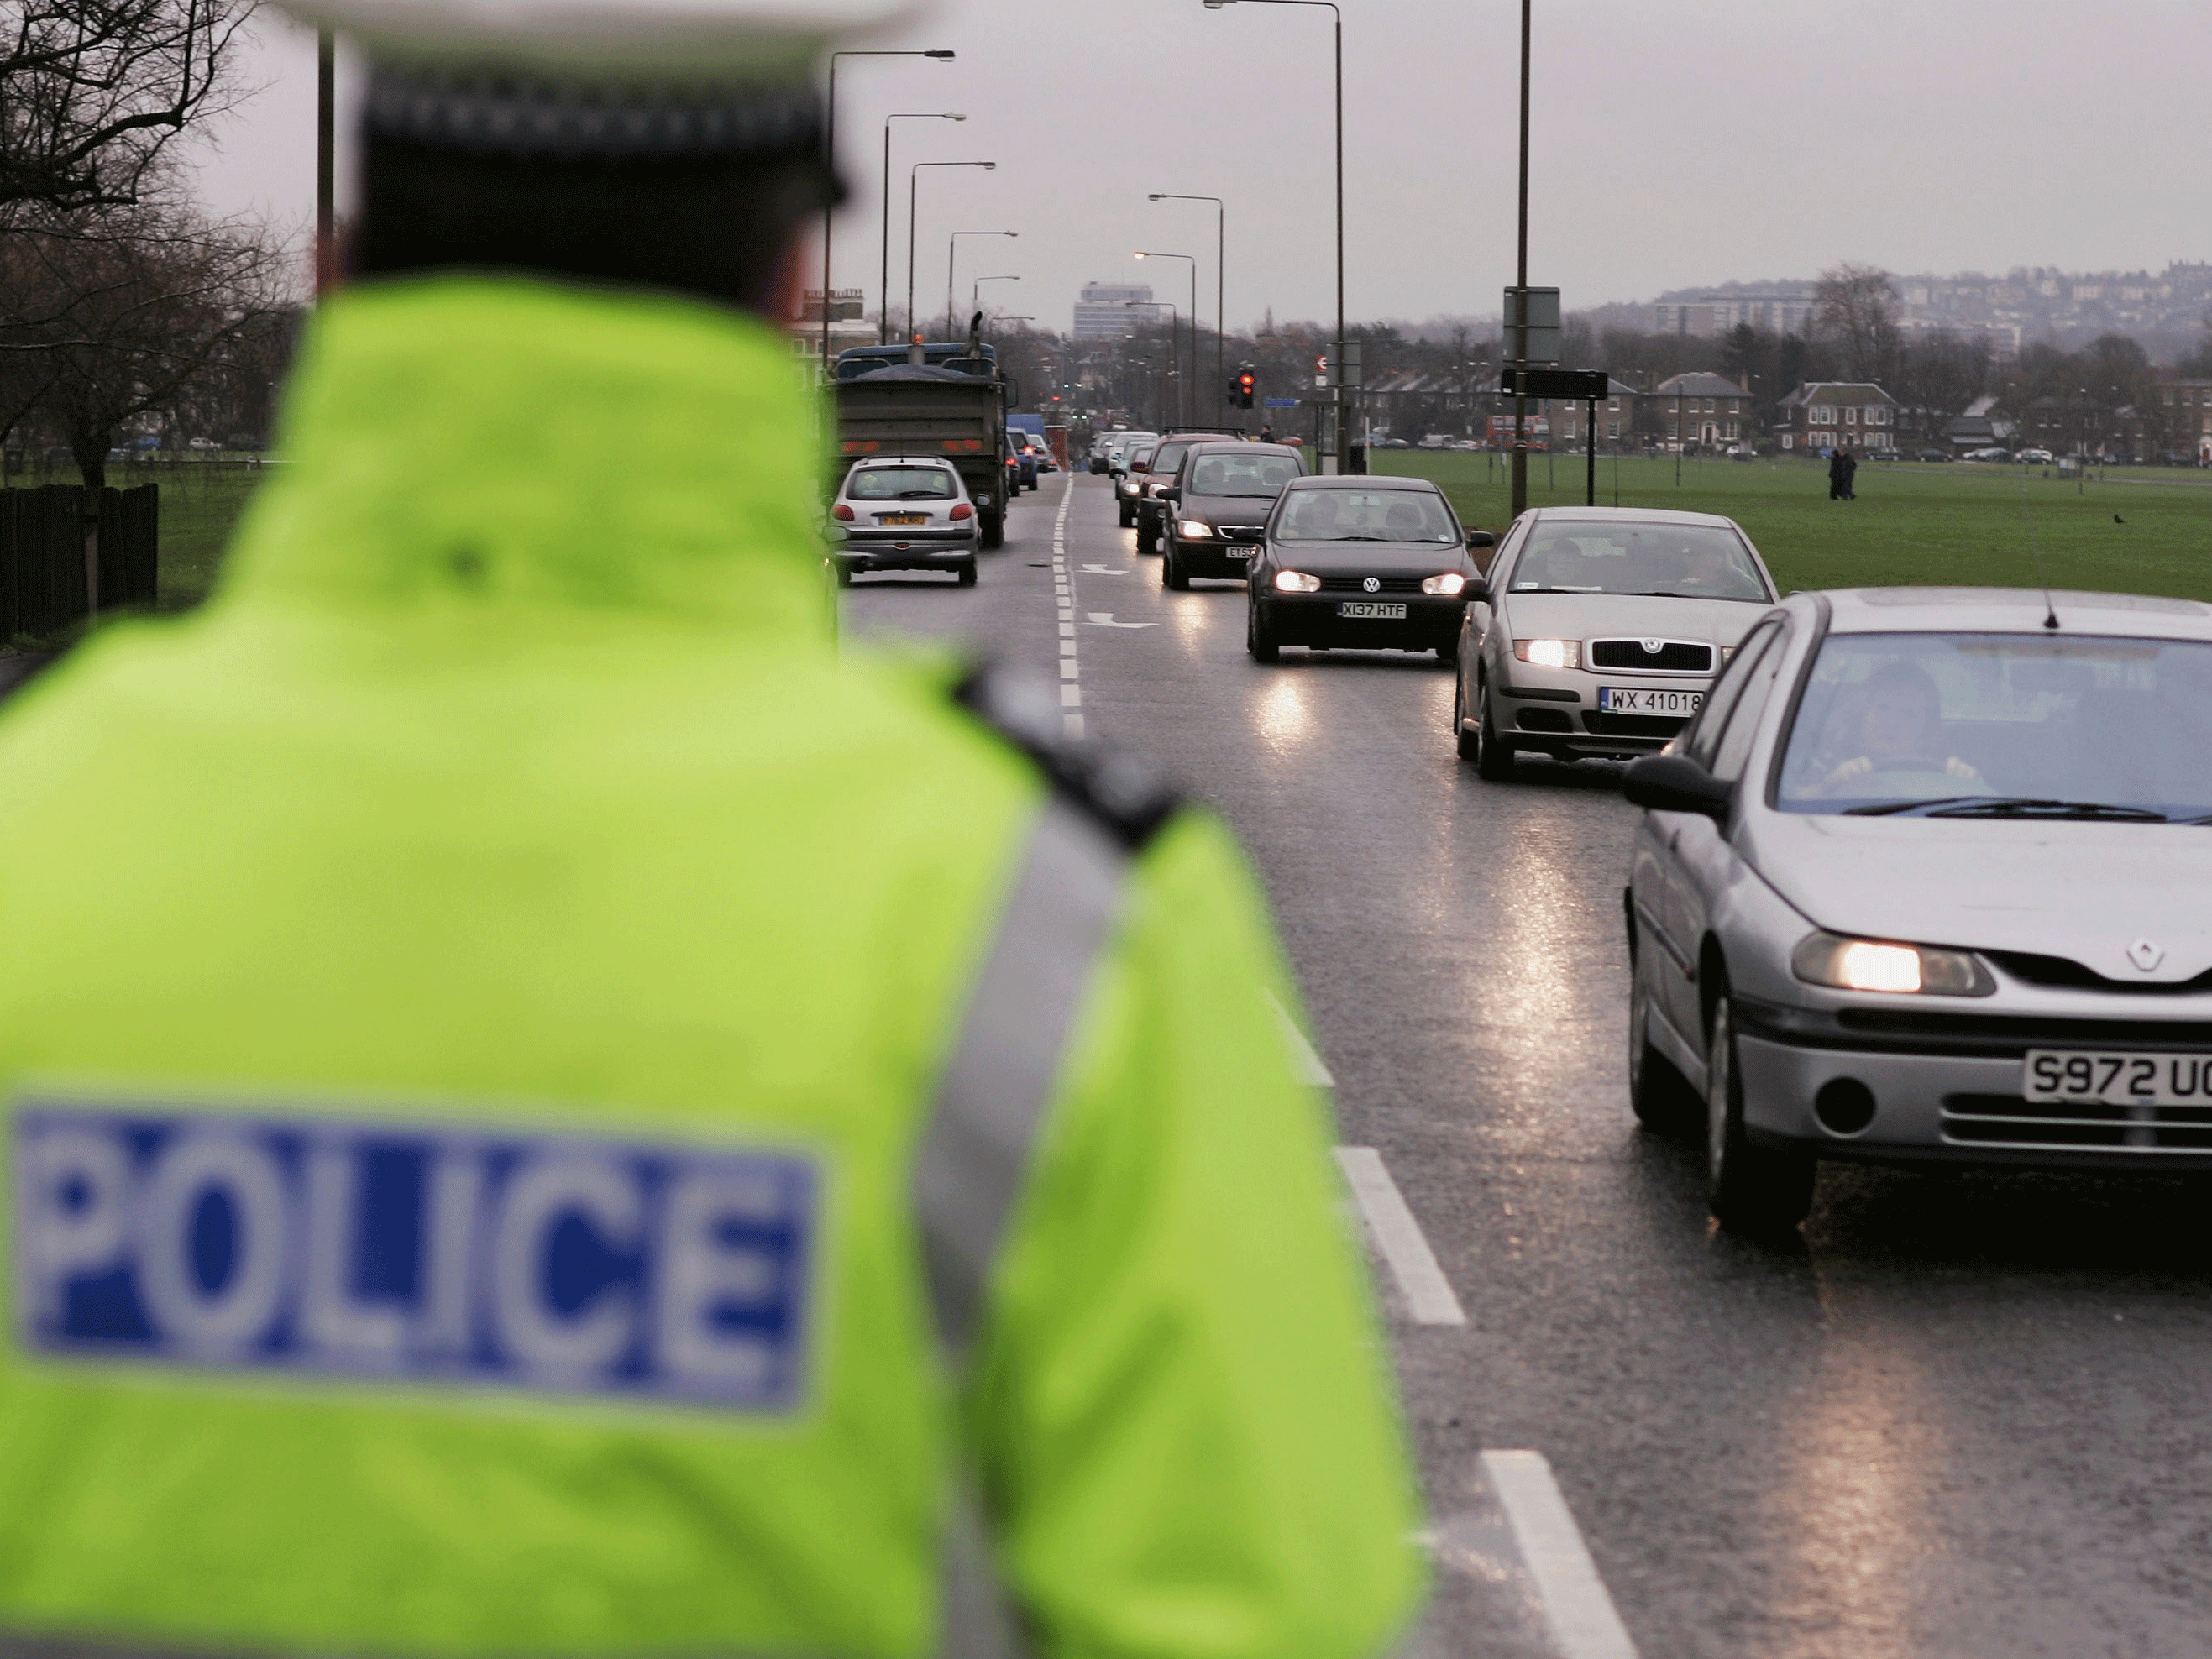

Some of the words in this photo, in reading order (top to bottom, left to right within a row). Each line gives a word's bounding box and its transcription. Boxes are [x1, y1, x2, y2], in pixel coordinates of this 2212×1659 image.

[1377, 604, 1405, 616] HTF
[1612, 691, 1637, 709] WX
[1645, 693, 1701, 711] 41018
[2034, 1055, 2156, 1096] S972
[13, 1121, 786, 1384] POLICE
